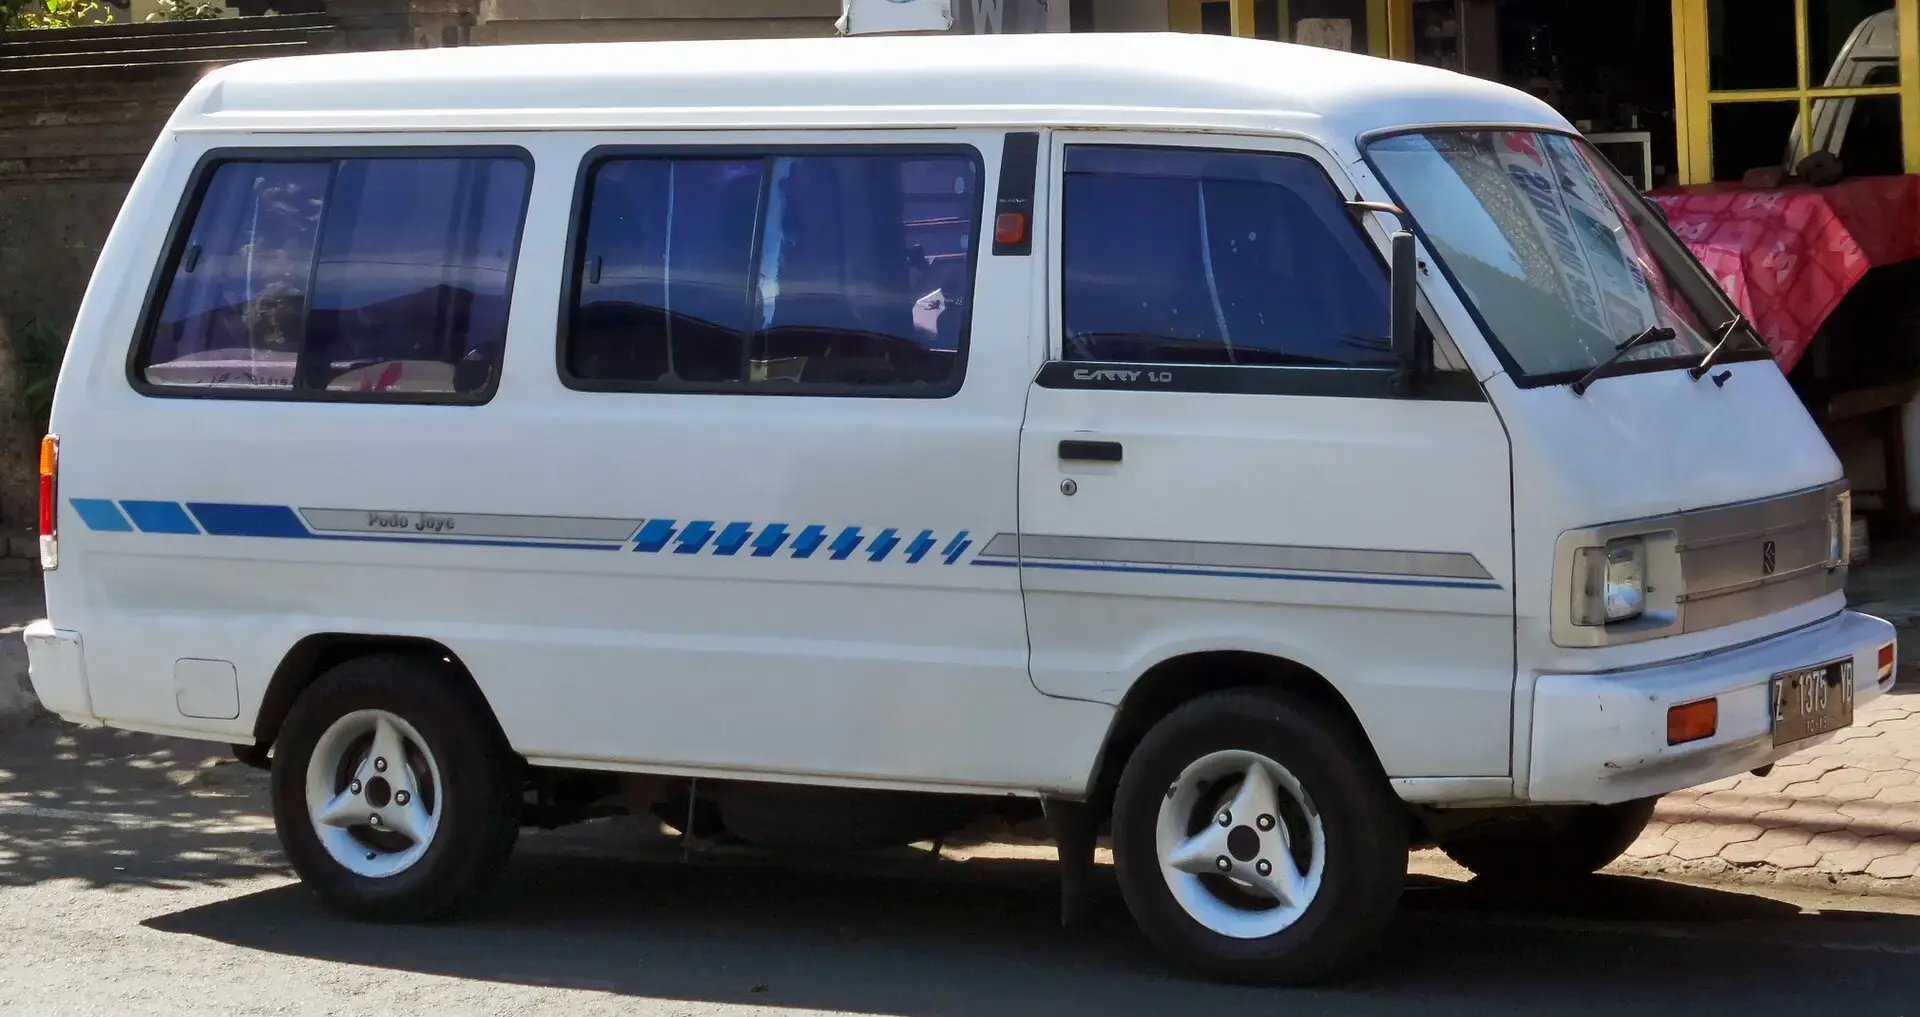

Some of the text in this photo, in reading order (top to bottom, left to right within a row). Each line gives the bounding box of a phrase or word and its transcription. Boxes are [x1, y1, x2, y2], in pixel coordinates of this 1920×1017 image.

[1073, 368, 1173, 383] CARRY 1.0
[1775, 662, 1853, 721] Z 1375 YB
